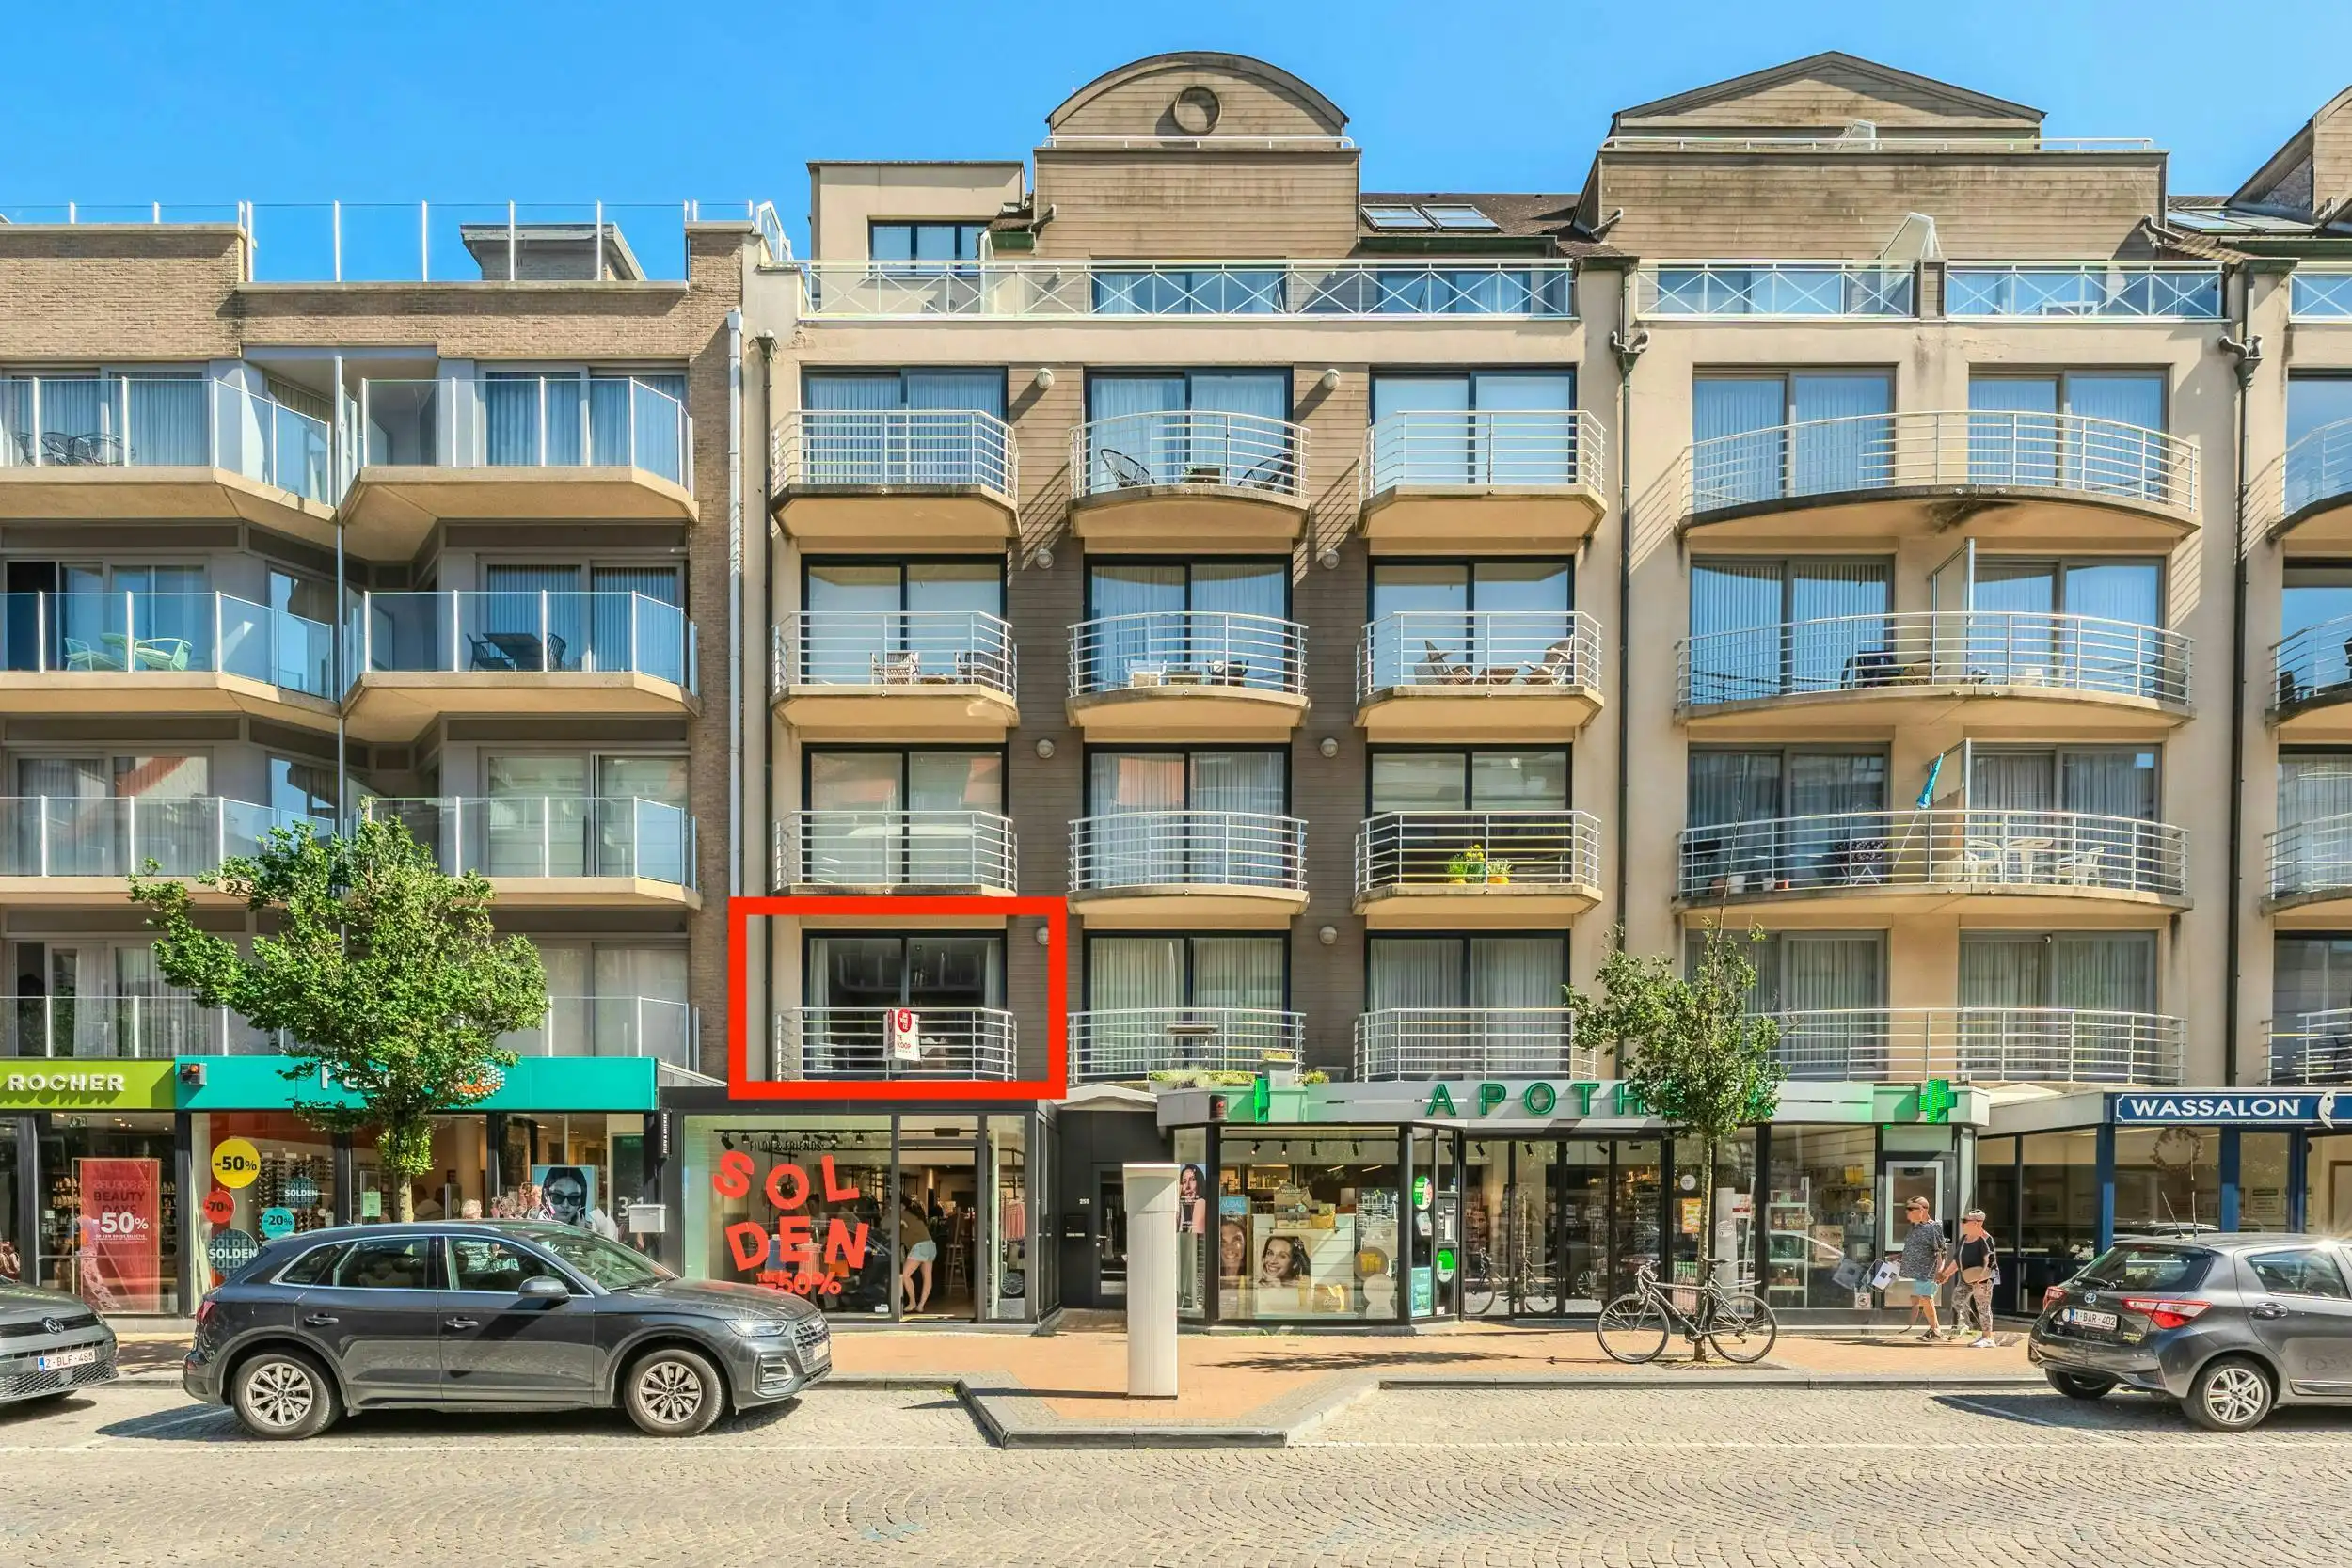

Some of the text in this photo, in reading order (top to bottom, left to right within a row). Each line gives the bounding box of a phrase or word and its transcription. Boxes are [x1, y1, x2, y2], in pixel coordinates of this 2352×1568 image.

[8, 1074, 125, 1091] ROCHER
[2130, 1099, 2300, 1116] WASSALON
[215, 1156, 257, 1171] -50%
[93, 1191, 145, 1202] BEAUTY
[103, 1204, 137, 1213] DAYS
[92, 1212, 149, 1234] -50%
[263, 1215, 293, 1226] -20%
[208, 1248, 258, 1259] SOLDEN
[45, 1351, 94, 1369] 2-BLF-485
